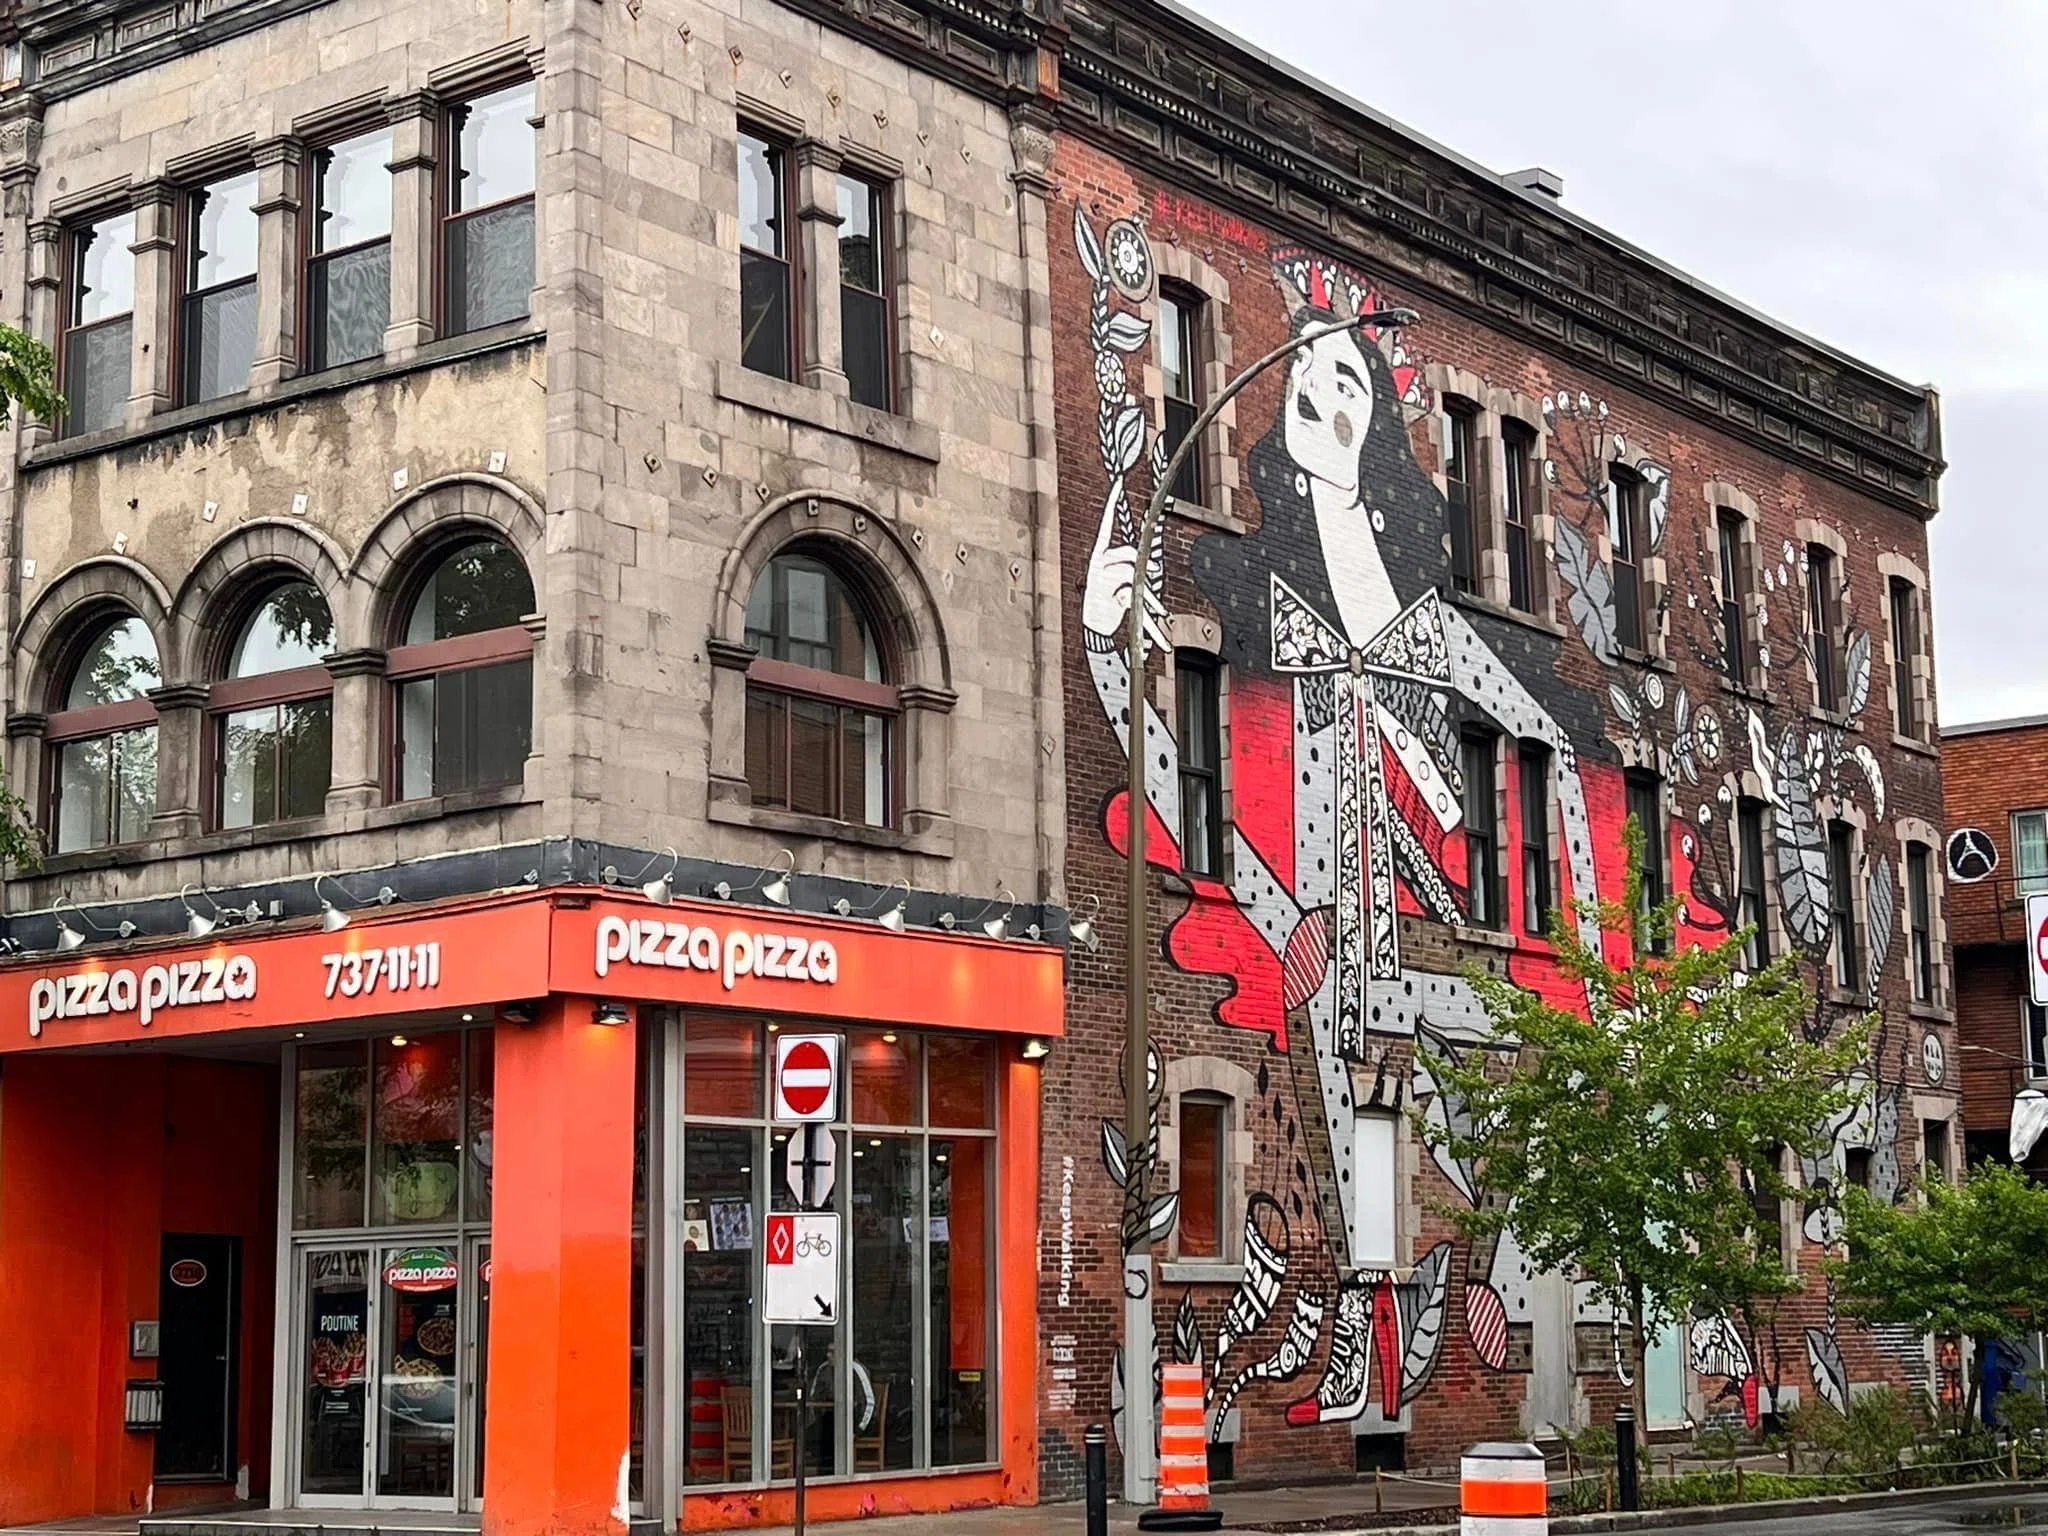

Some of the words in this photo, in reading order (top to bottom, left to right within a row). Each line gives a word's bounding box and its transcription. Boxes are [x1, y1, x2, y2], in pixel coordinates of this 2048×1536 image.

[595, 915, 720, 977] pizza
[722, 930, 838, 990] pizza
[29, 968, 138, 1037] pizza
[140, 954, 257, 1026] pizza
[1058, 1156, 1074, 1307] #KeepWalking
[423, 1266, 457, 1284] pizza
[320, 1315, 359, 1332] POUTINE
